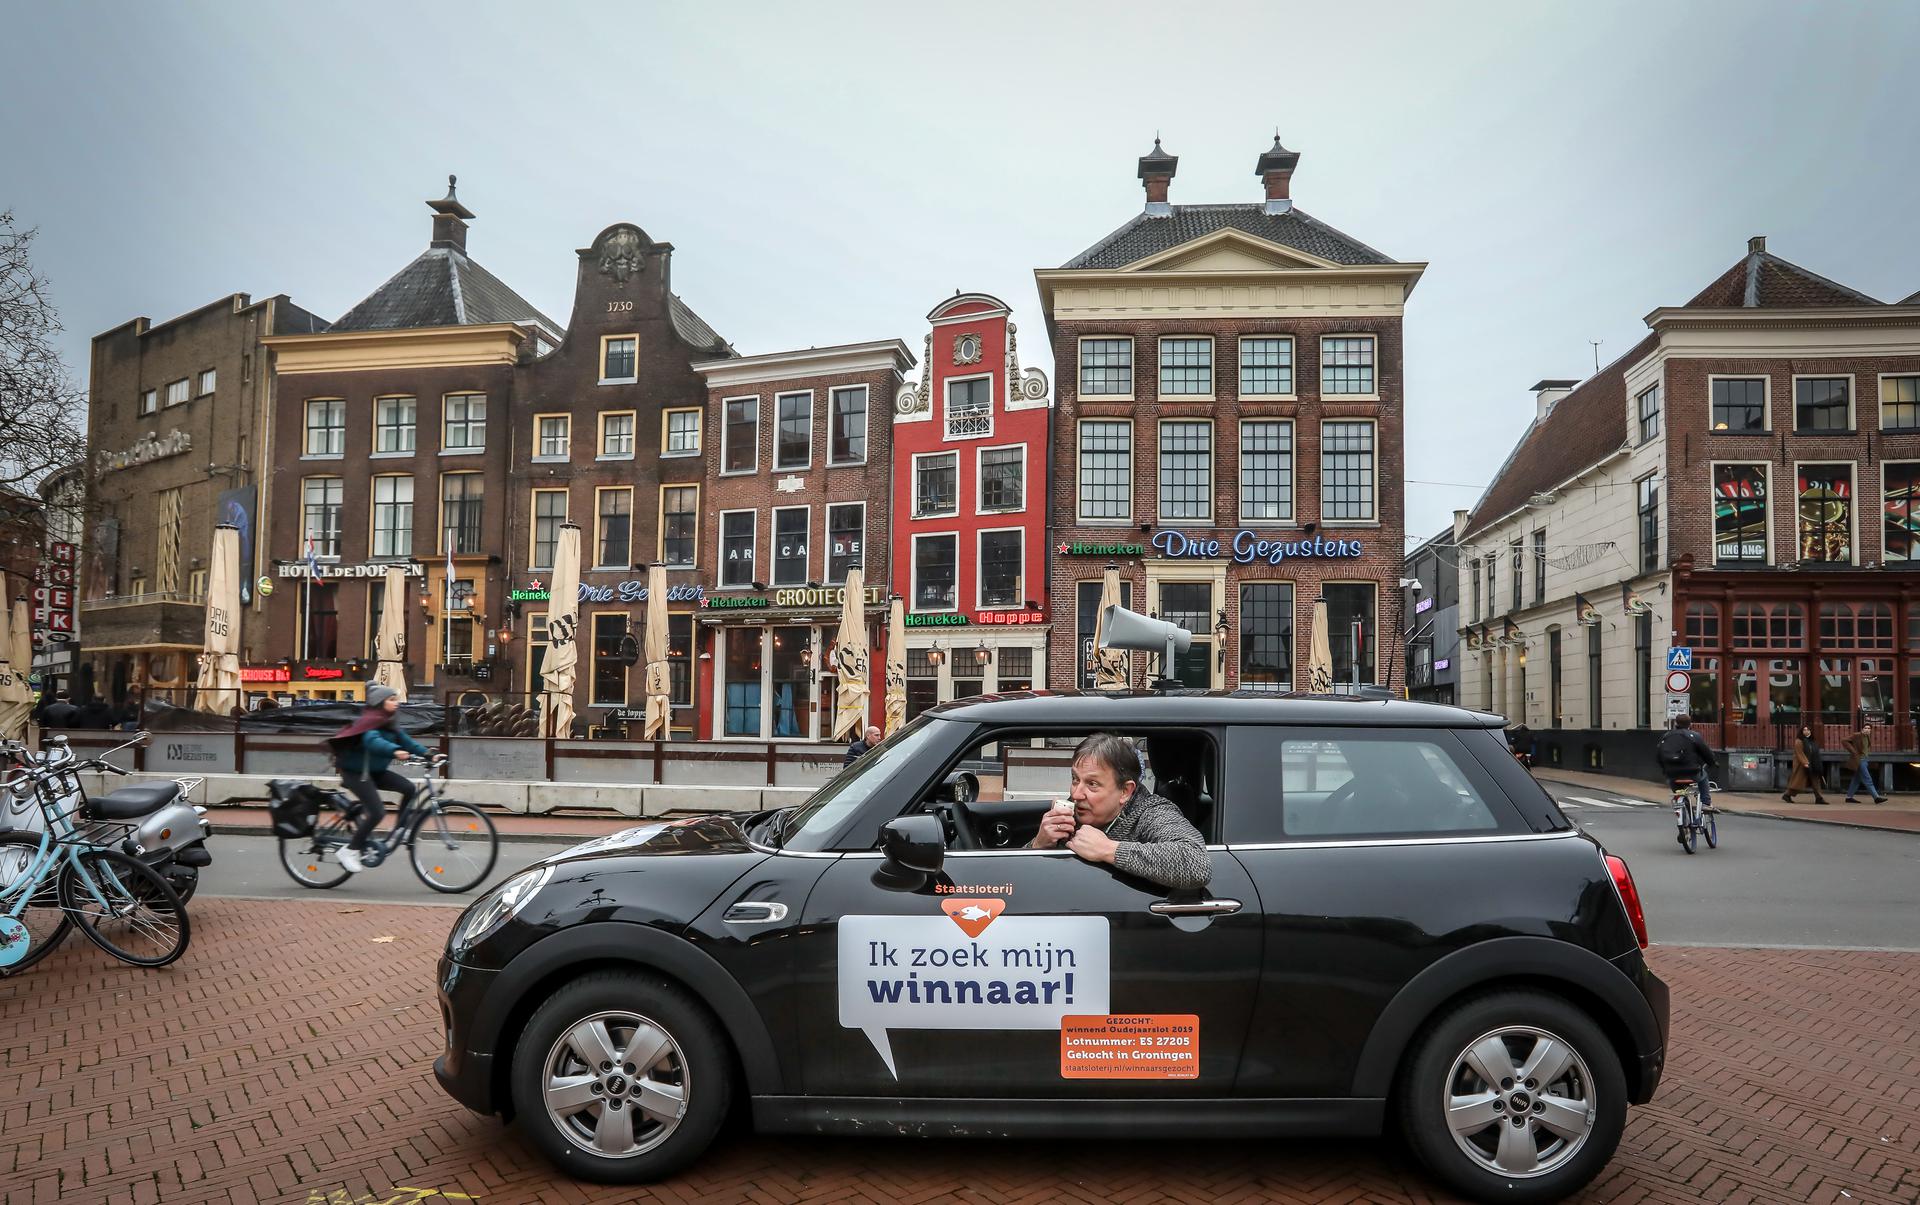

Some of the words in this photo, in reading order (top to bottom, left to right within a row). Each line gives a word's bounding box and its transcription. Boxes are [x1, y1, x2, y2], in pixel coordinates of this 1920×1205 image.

[1073, 542, 1145, 556] Heineken
[1152, 530, 1219, 557] Drie
[1233, 529, 1362, 565] Gezusters
[355, 563, 425, 578] DOEEN
[512, 590, 550, 600] Heineke
[776, 588, 834, 606] GROOTE
[836, 588, 880, 605] GET
[711, 597, 767, 608] Heineken
[905, 613, 967, 626] Heineken
[979, 612, 1043, 625] Hoppe
[935, 884, 1013, 896] Staatsloterij
[869, 941, 898, 967] Ik
[911, 941, 989, 967] zoek
[1001, 942, 1076, 974] mijn
[867, 971, 1074, 1005] winnaar!
[1106, 1017, 1154, 1025] GEZOCHT:
[1109, 1025, 1169, 1034] Oudejaarslot
[1066, 1036, 1136, 1046] Lotnummer:
[1140, 1037, 1153, 1046] ES
[1156, 1037, 1190, 1046] 27205
[1067, 1050, 1113, 1059] Gekocht
[1117, 1050, 1129, 1059] in
[1132, 1050, 1193, 1062] Groningen
